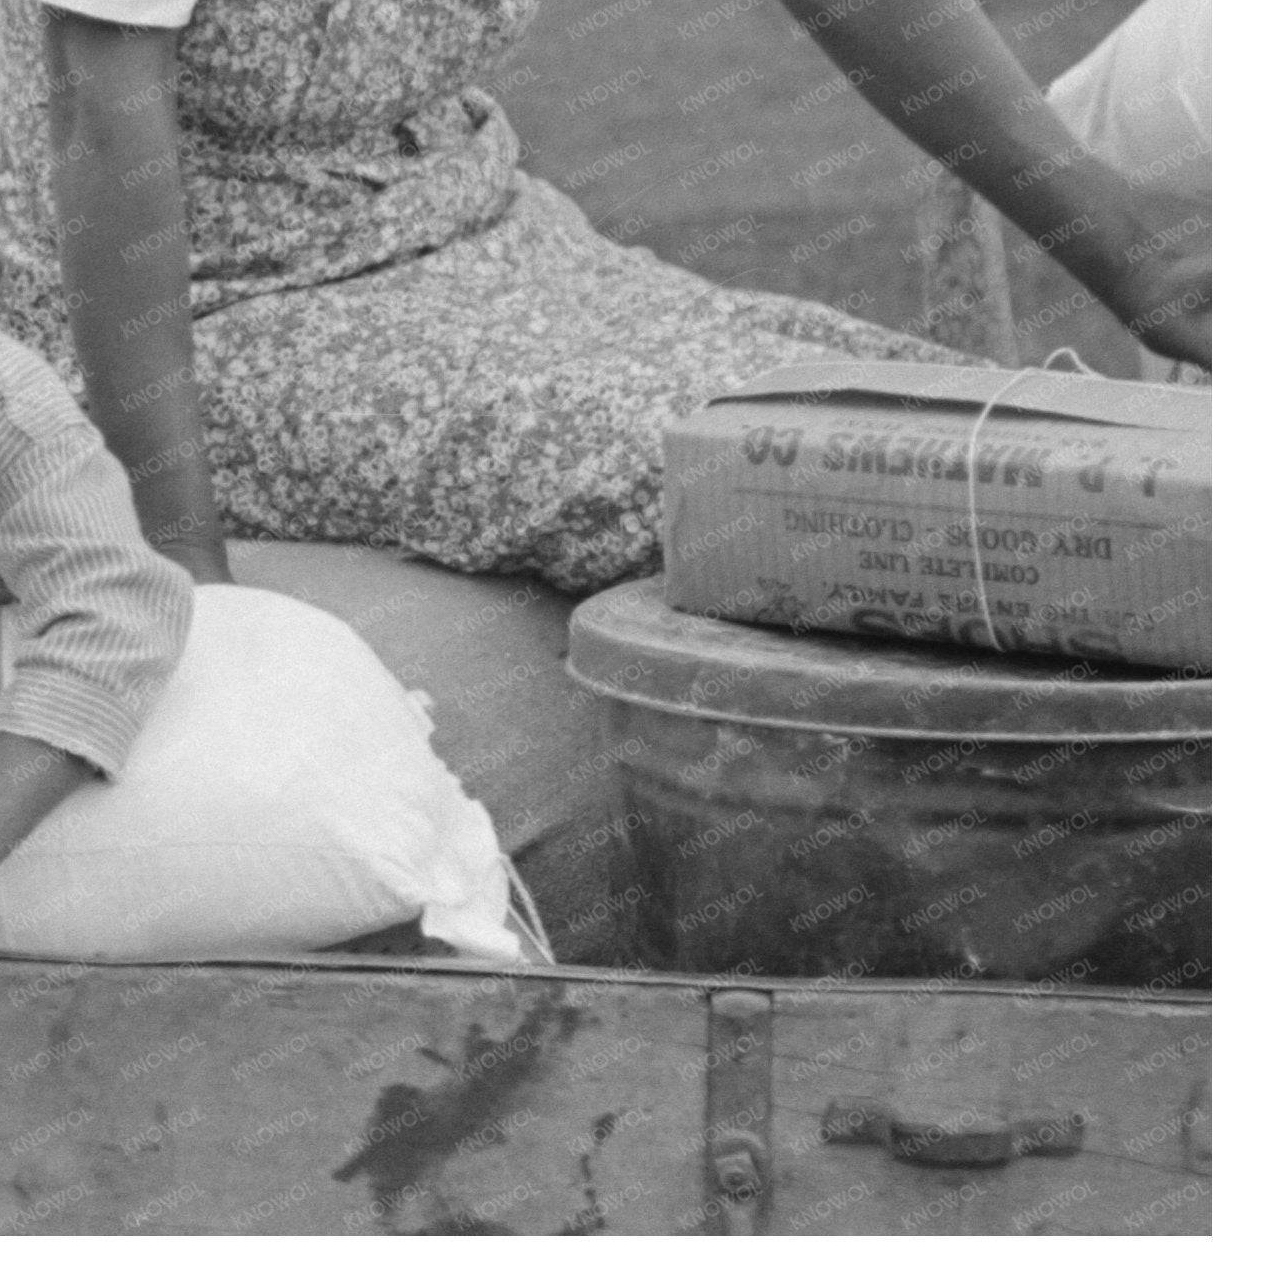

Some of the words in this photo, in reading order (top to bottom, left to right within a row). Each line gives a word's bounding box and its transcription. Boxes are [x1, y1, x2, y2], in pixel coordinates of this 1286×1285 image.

[784, 509, 915, 543] CLOTHING
[948, 525, 1037, 555] GOODS
[859, 550, 909, 573] LINE
[1053, 534, 1112, 561] DRY
[920, 557, 1039, 586] COMPLETE
